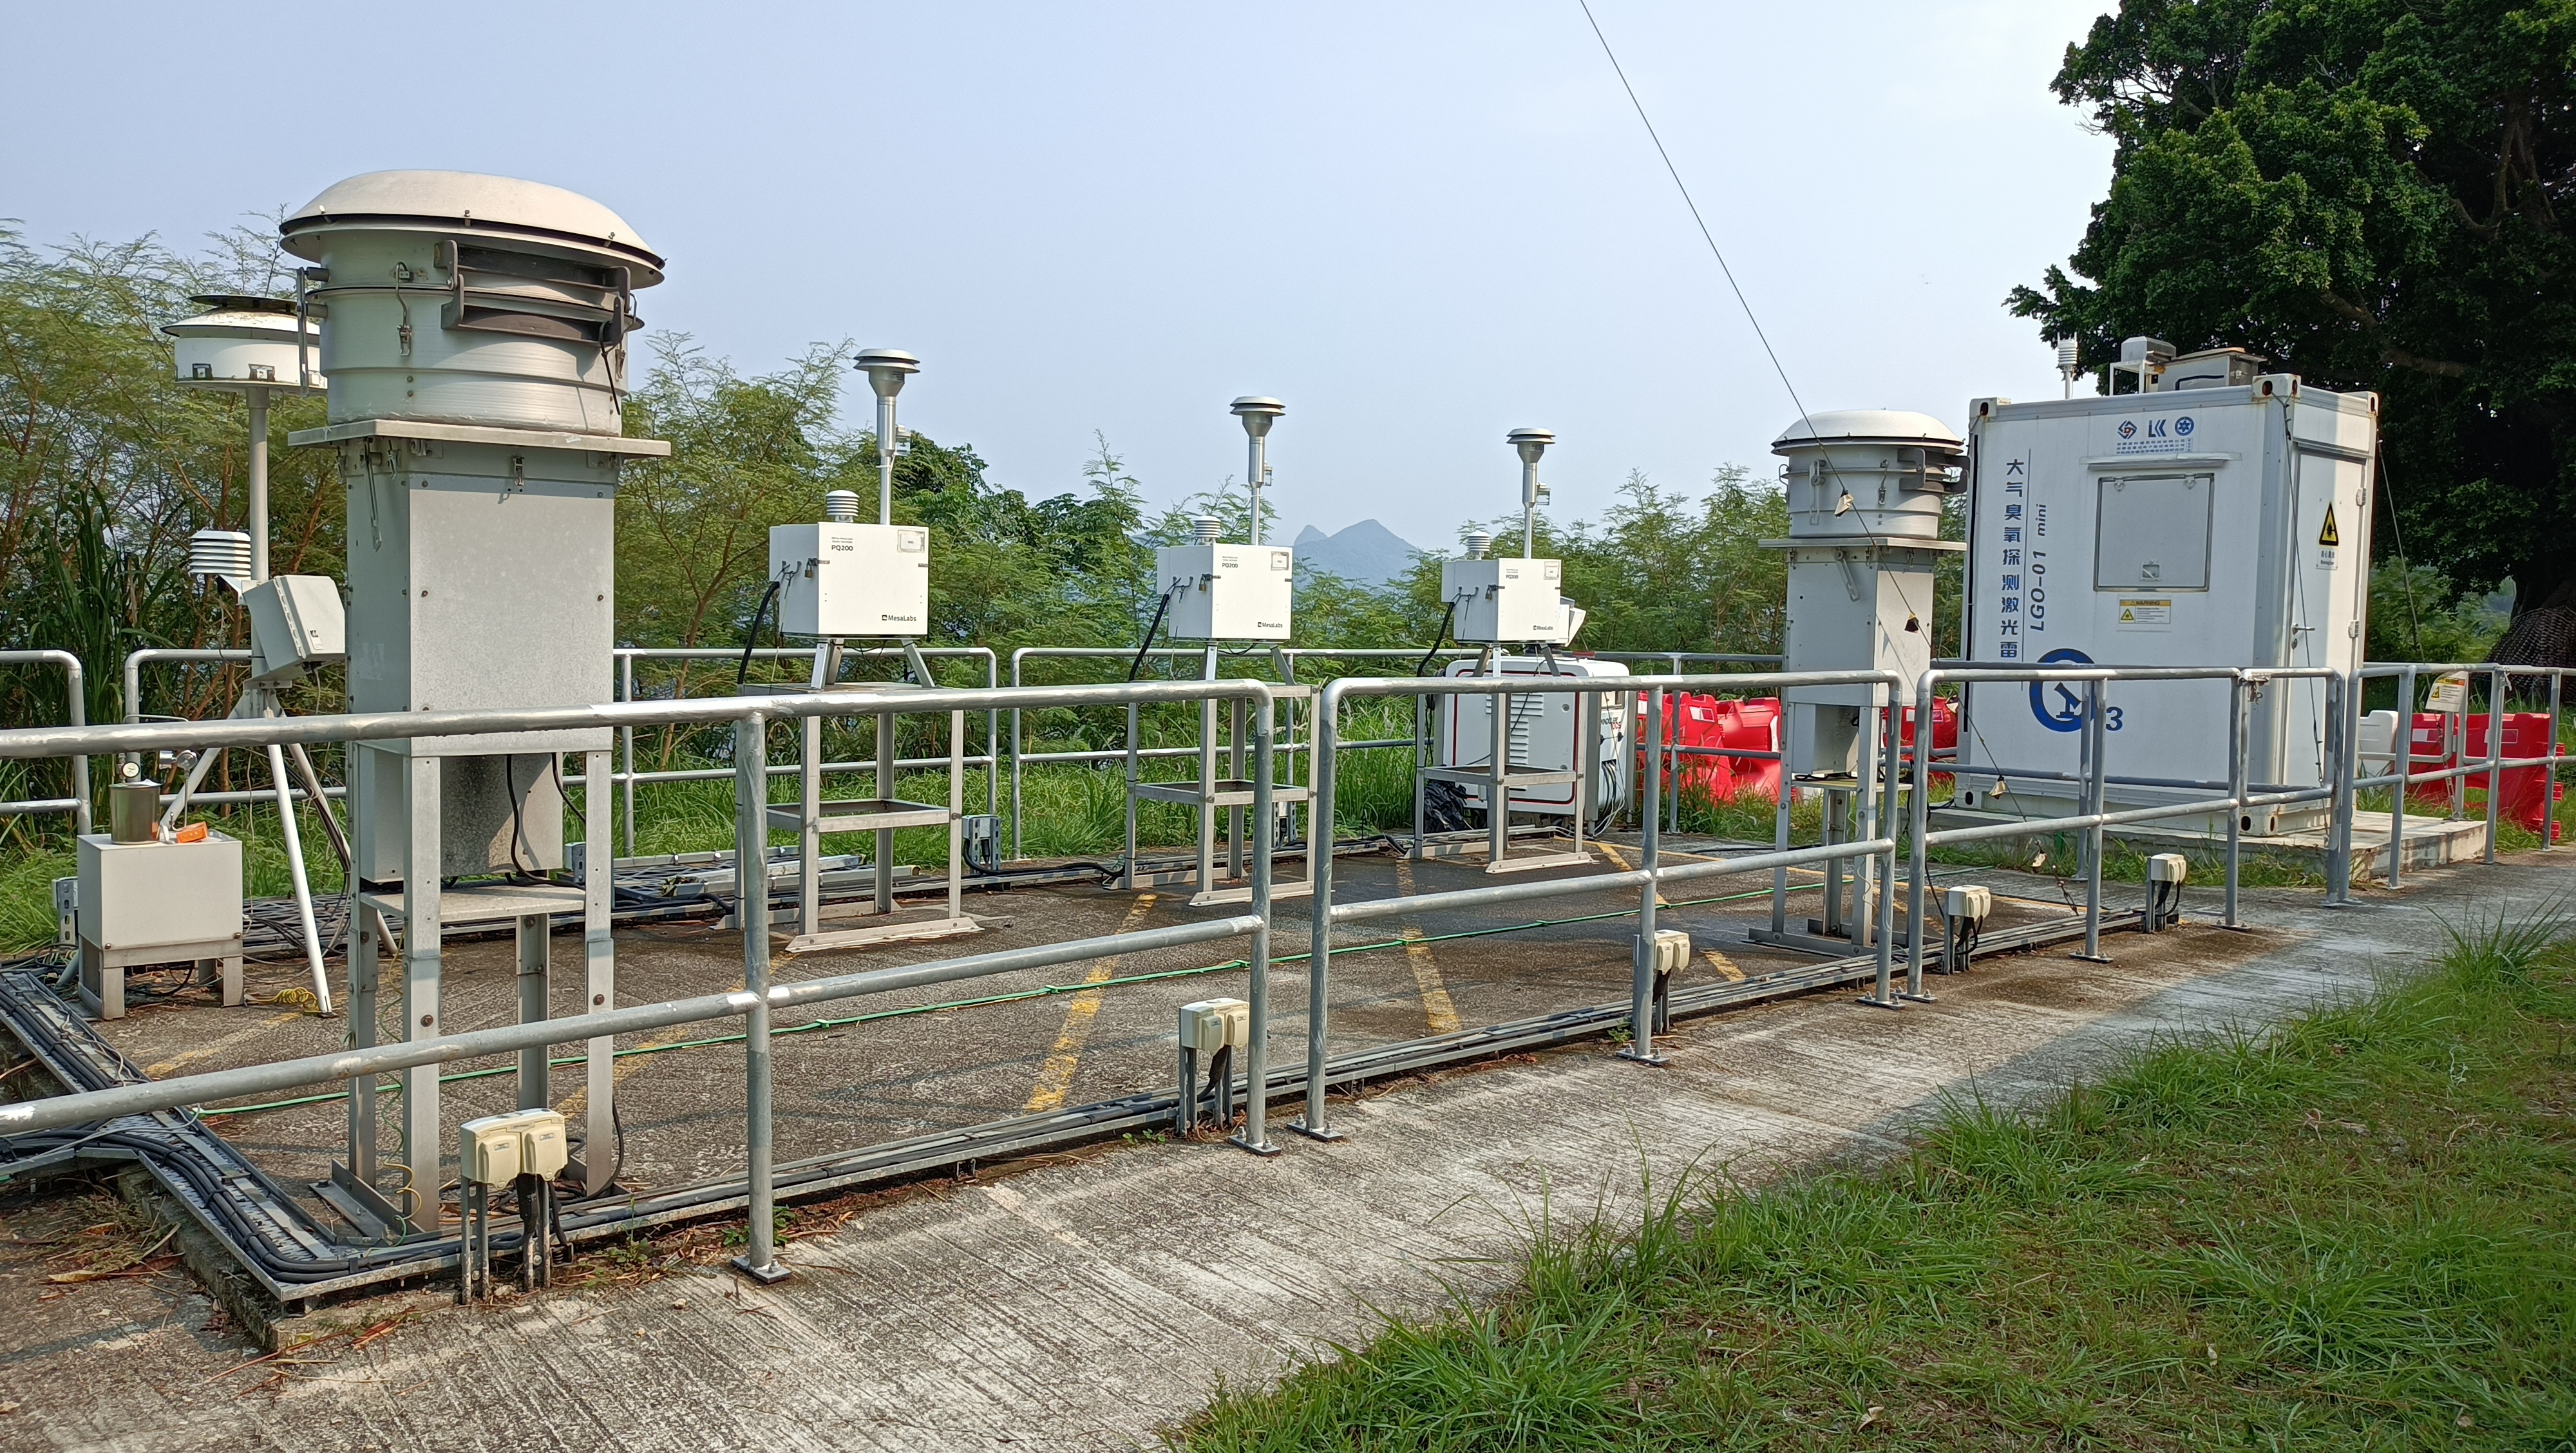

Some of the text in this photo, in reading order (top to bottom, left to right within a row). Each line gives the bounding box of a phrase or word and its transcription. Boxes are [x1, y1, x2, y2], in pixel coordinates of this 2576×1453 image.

[2000, 458, 2025, 659] 大气臭氧探测激光雷
[2030, 503, 2047, 632] LGO-01 mini
